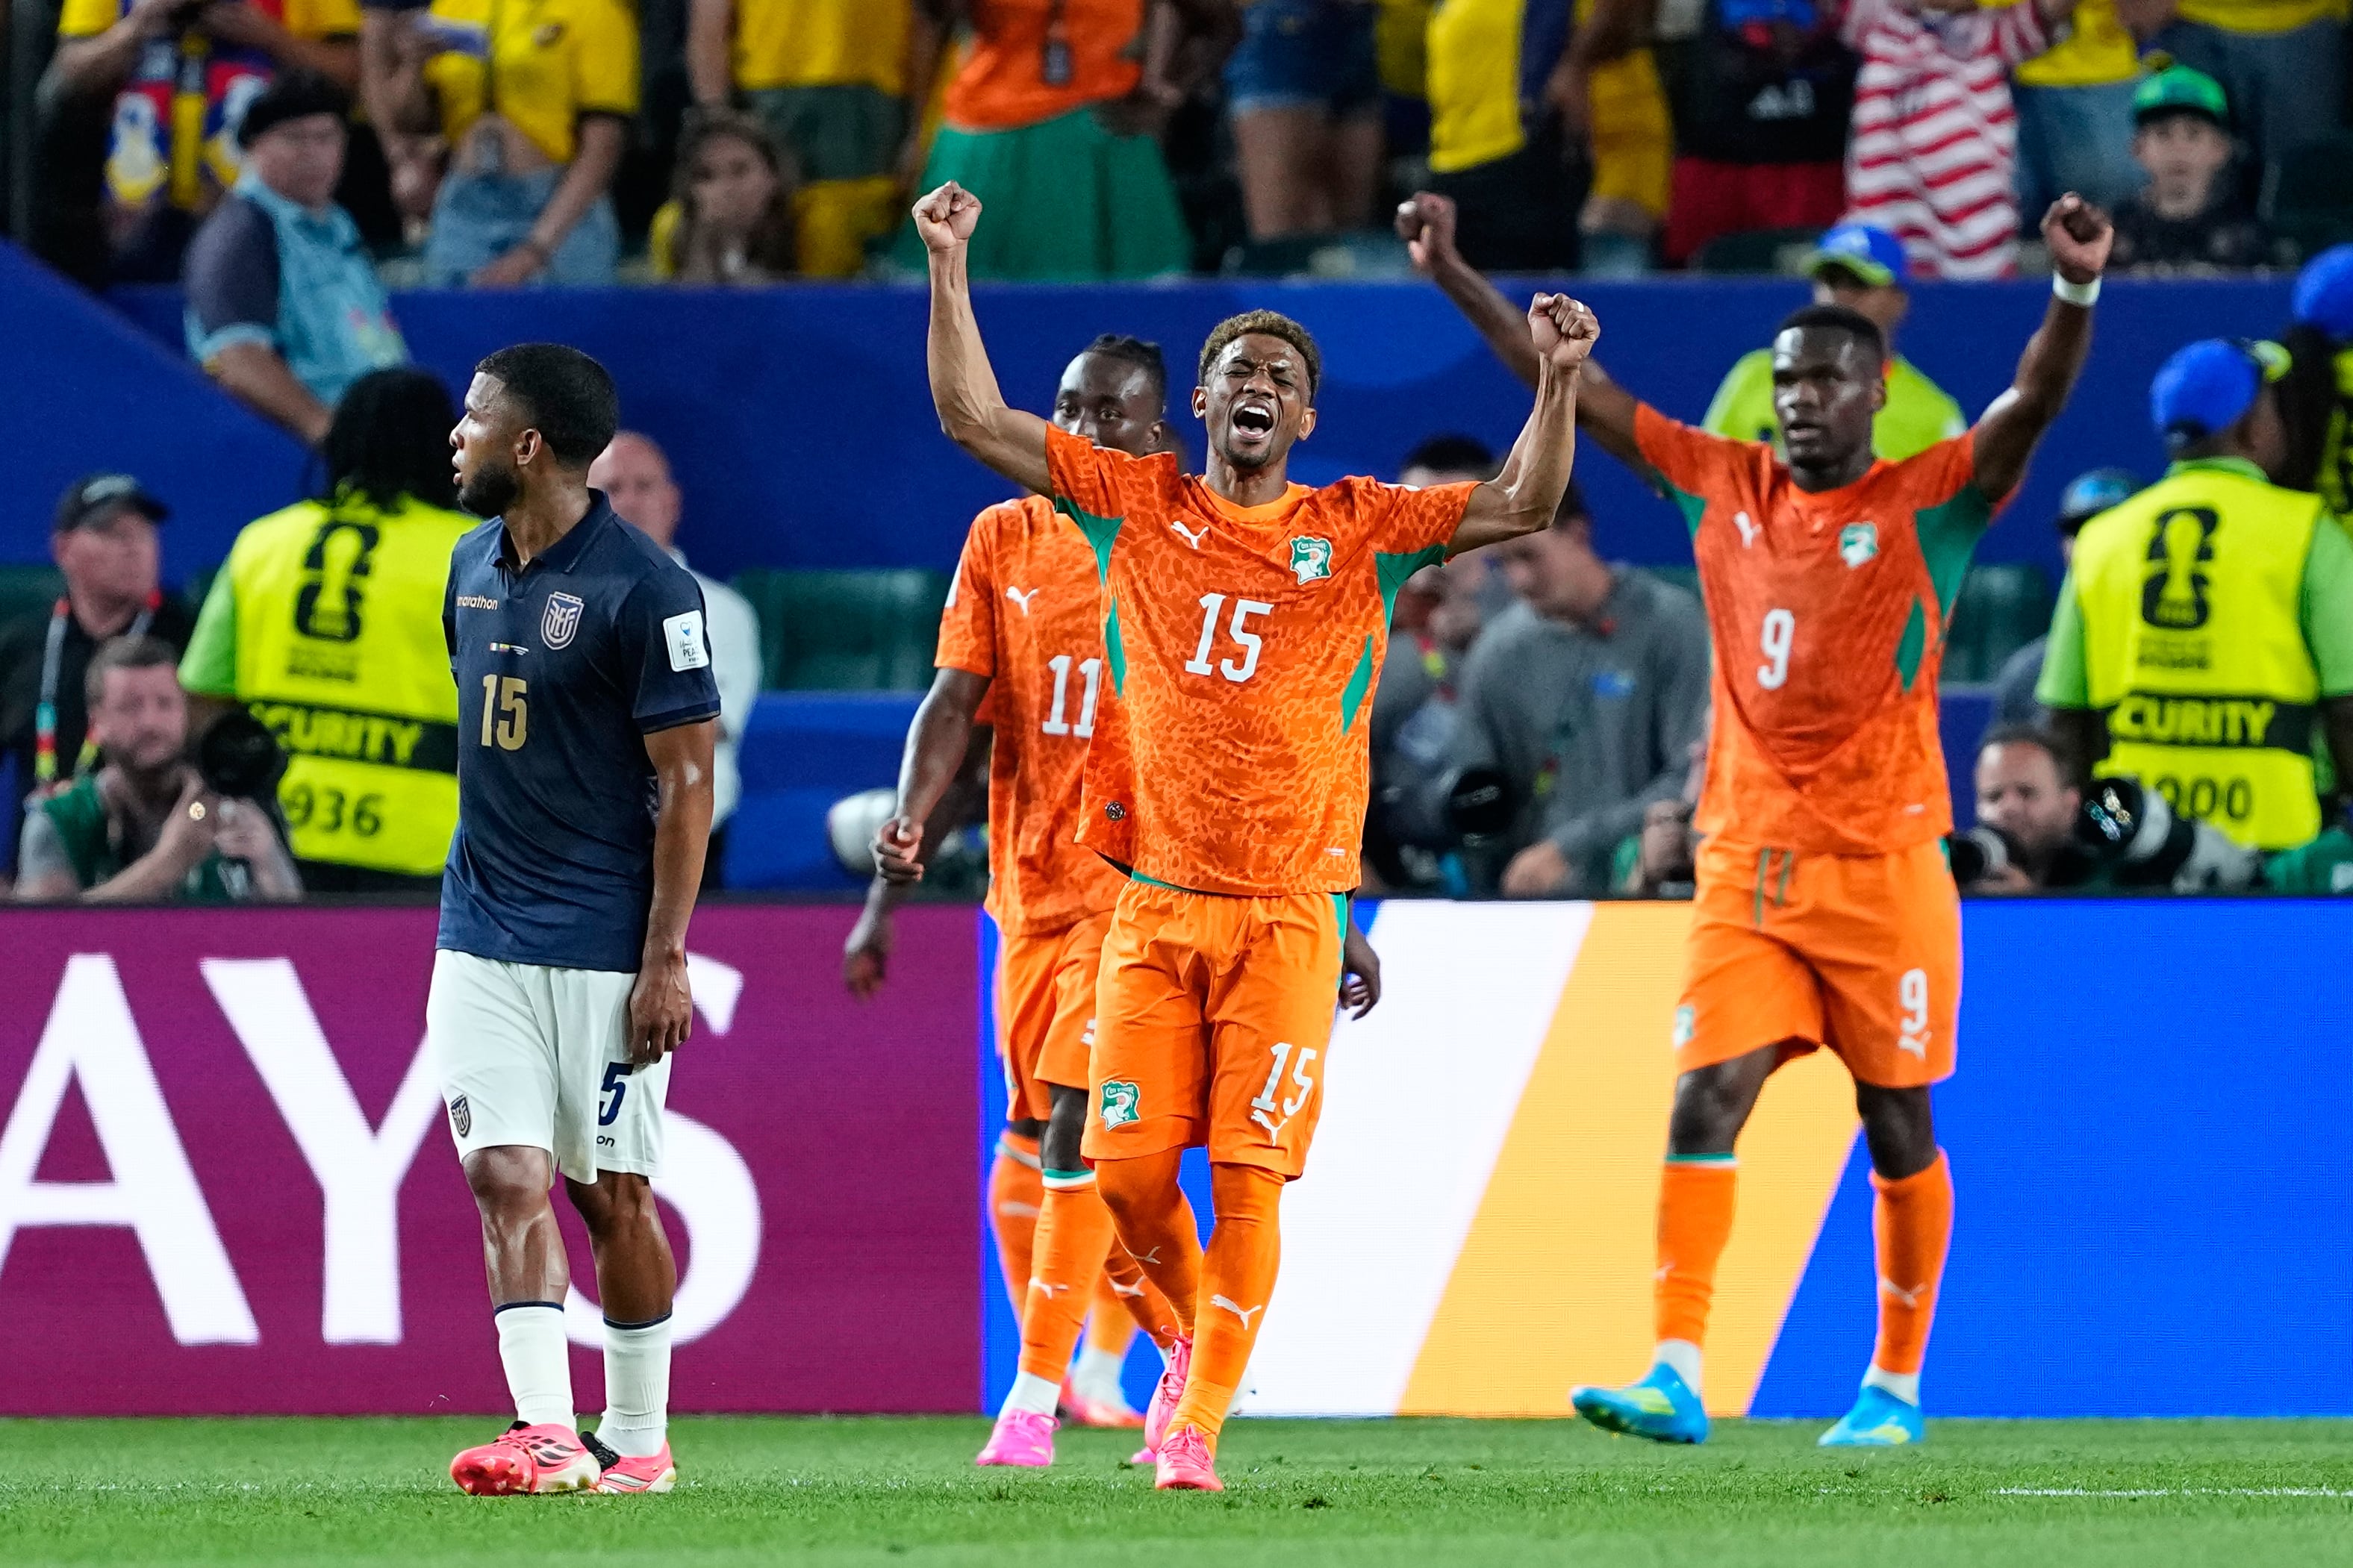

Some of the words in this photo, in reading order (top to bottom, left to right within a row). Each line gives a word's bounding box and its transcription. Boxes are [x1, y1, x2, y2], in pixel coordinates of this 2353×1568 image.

[457, 595, 498, 610] marathon
[1185, 592, 1274, 683] 15
[1757, 608, 1795, 689] 9
[249, 703, 423, 764] CURITY
[481, 674, 528, 751] 15
[1042, 655, 1102, 738] 11
[1900, 968, 1927, 1033] 9
[598, 1061, 634, 1126] 5
[1250, 1042, 1318, 1117] 15
